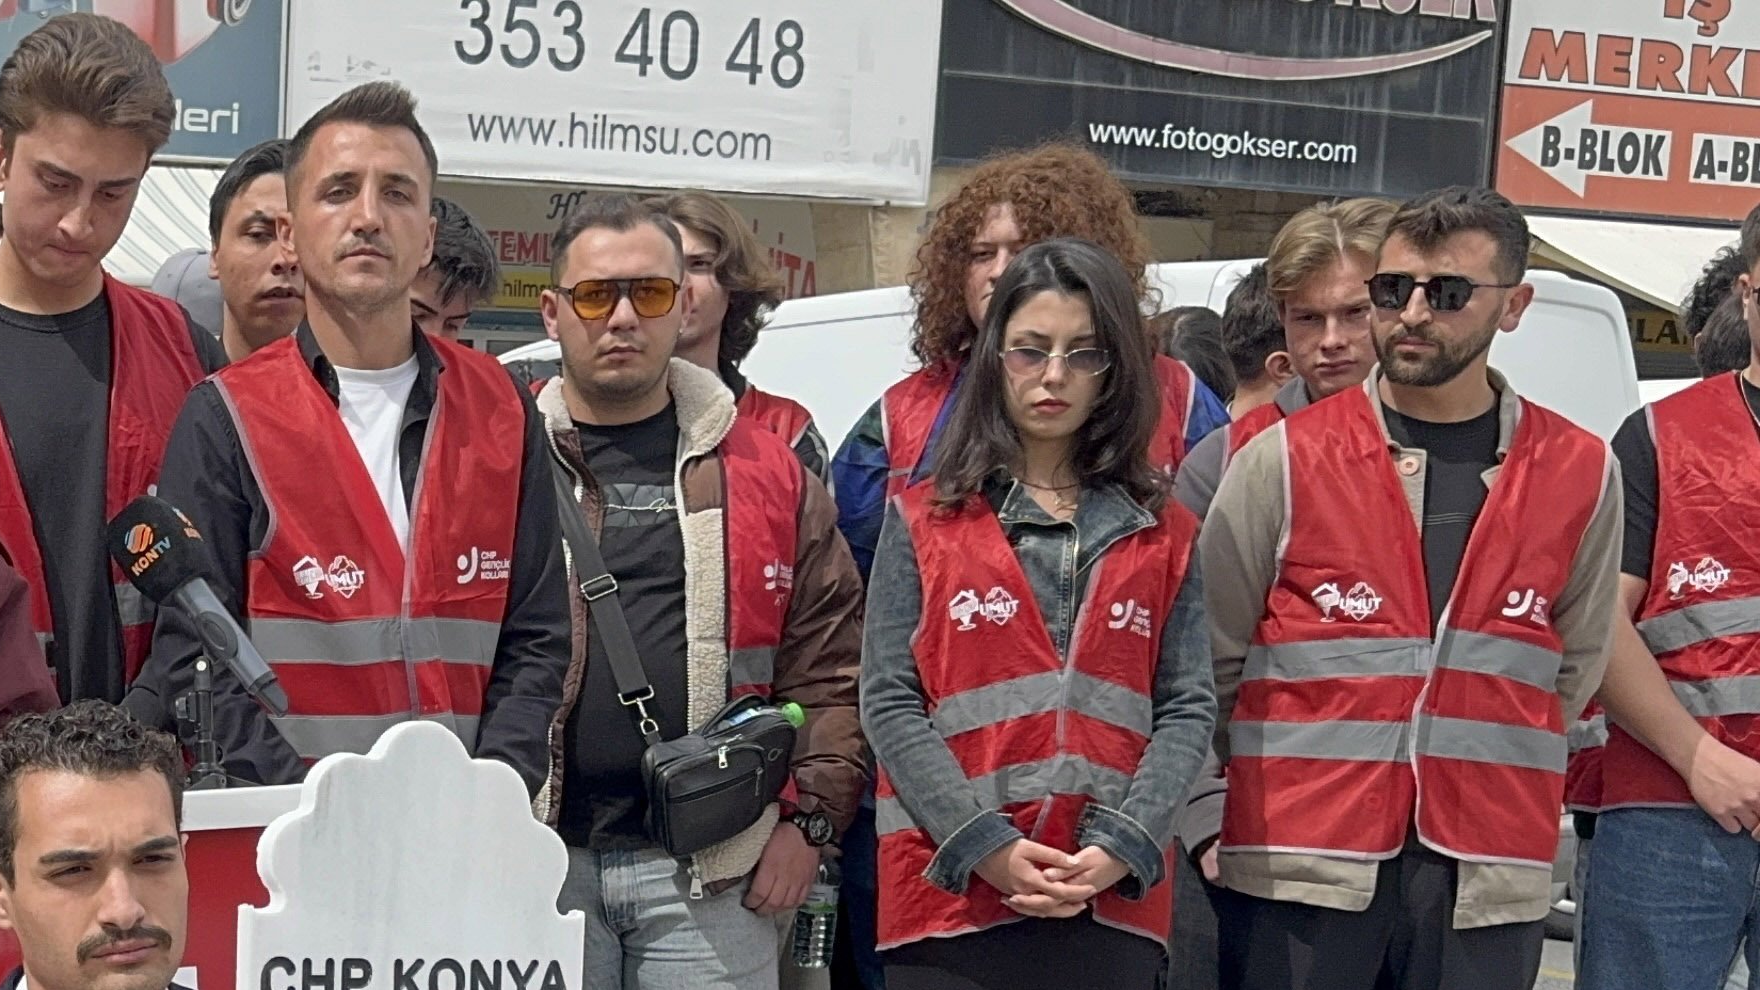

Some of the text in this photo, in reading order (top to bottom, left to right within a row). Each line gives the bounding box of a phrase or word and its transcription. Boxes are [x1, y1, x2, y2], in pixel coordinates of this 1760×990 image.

[454, 0, 805, 89] 353 40 48
[467, 111, 772, 162] www.hilmsu.com
[1088, 121, 1358, 165] www.fotogokser.com
[1540, 124, 1667, 177] B-BLOK
[130, 536, 172, 577] KONTV
[1688, 568, 1731, 586] UMUT
[324, 570, 366, 590] UMUT
[979, 599, 1020, 618] UMUT
[1340, 597, 1383, 611] UMUT
